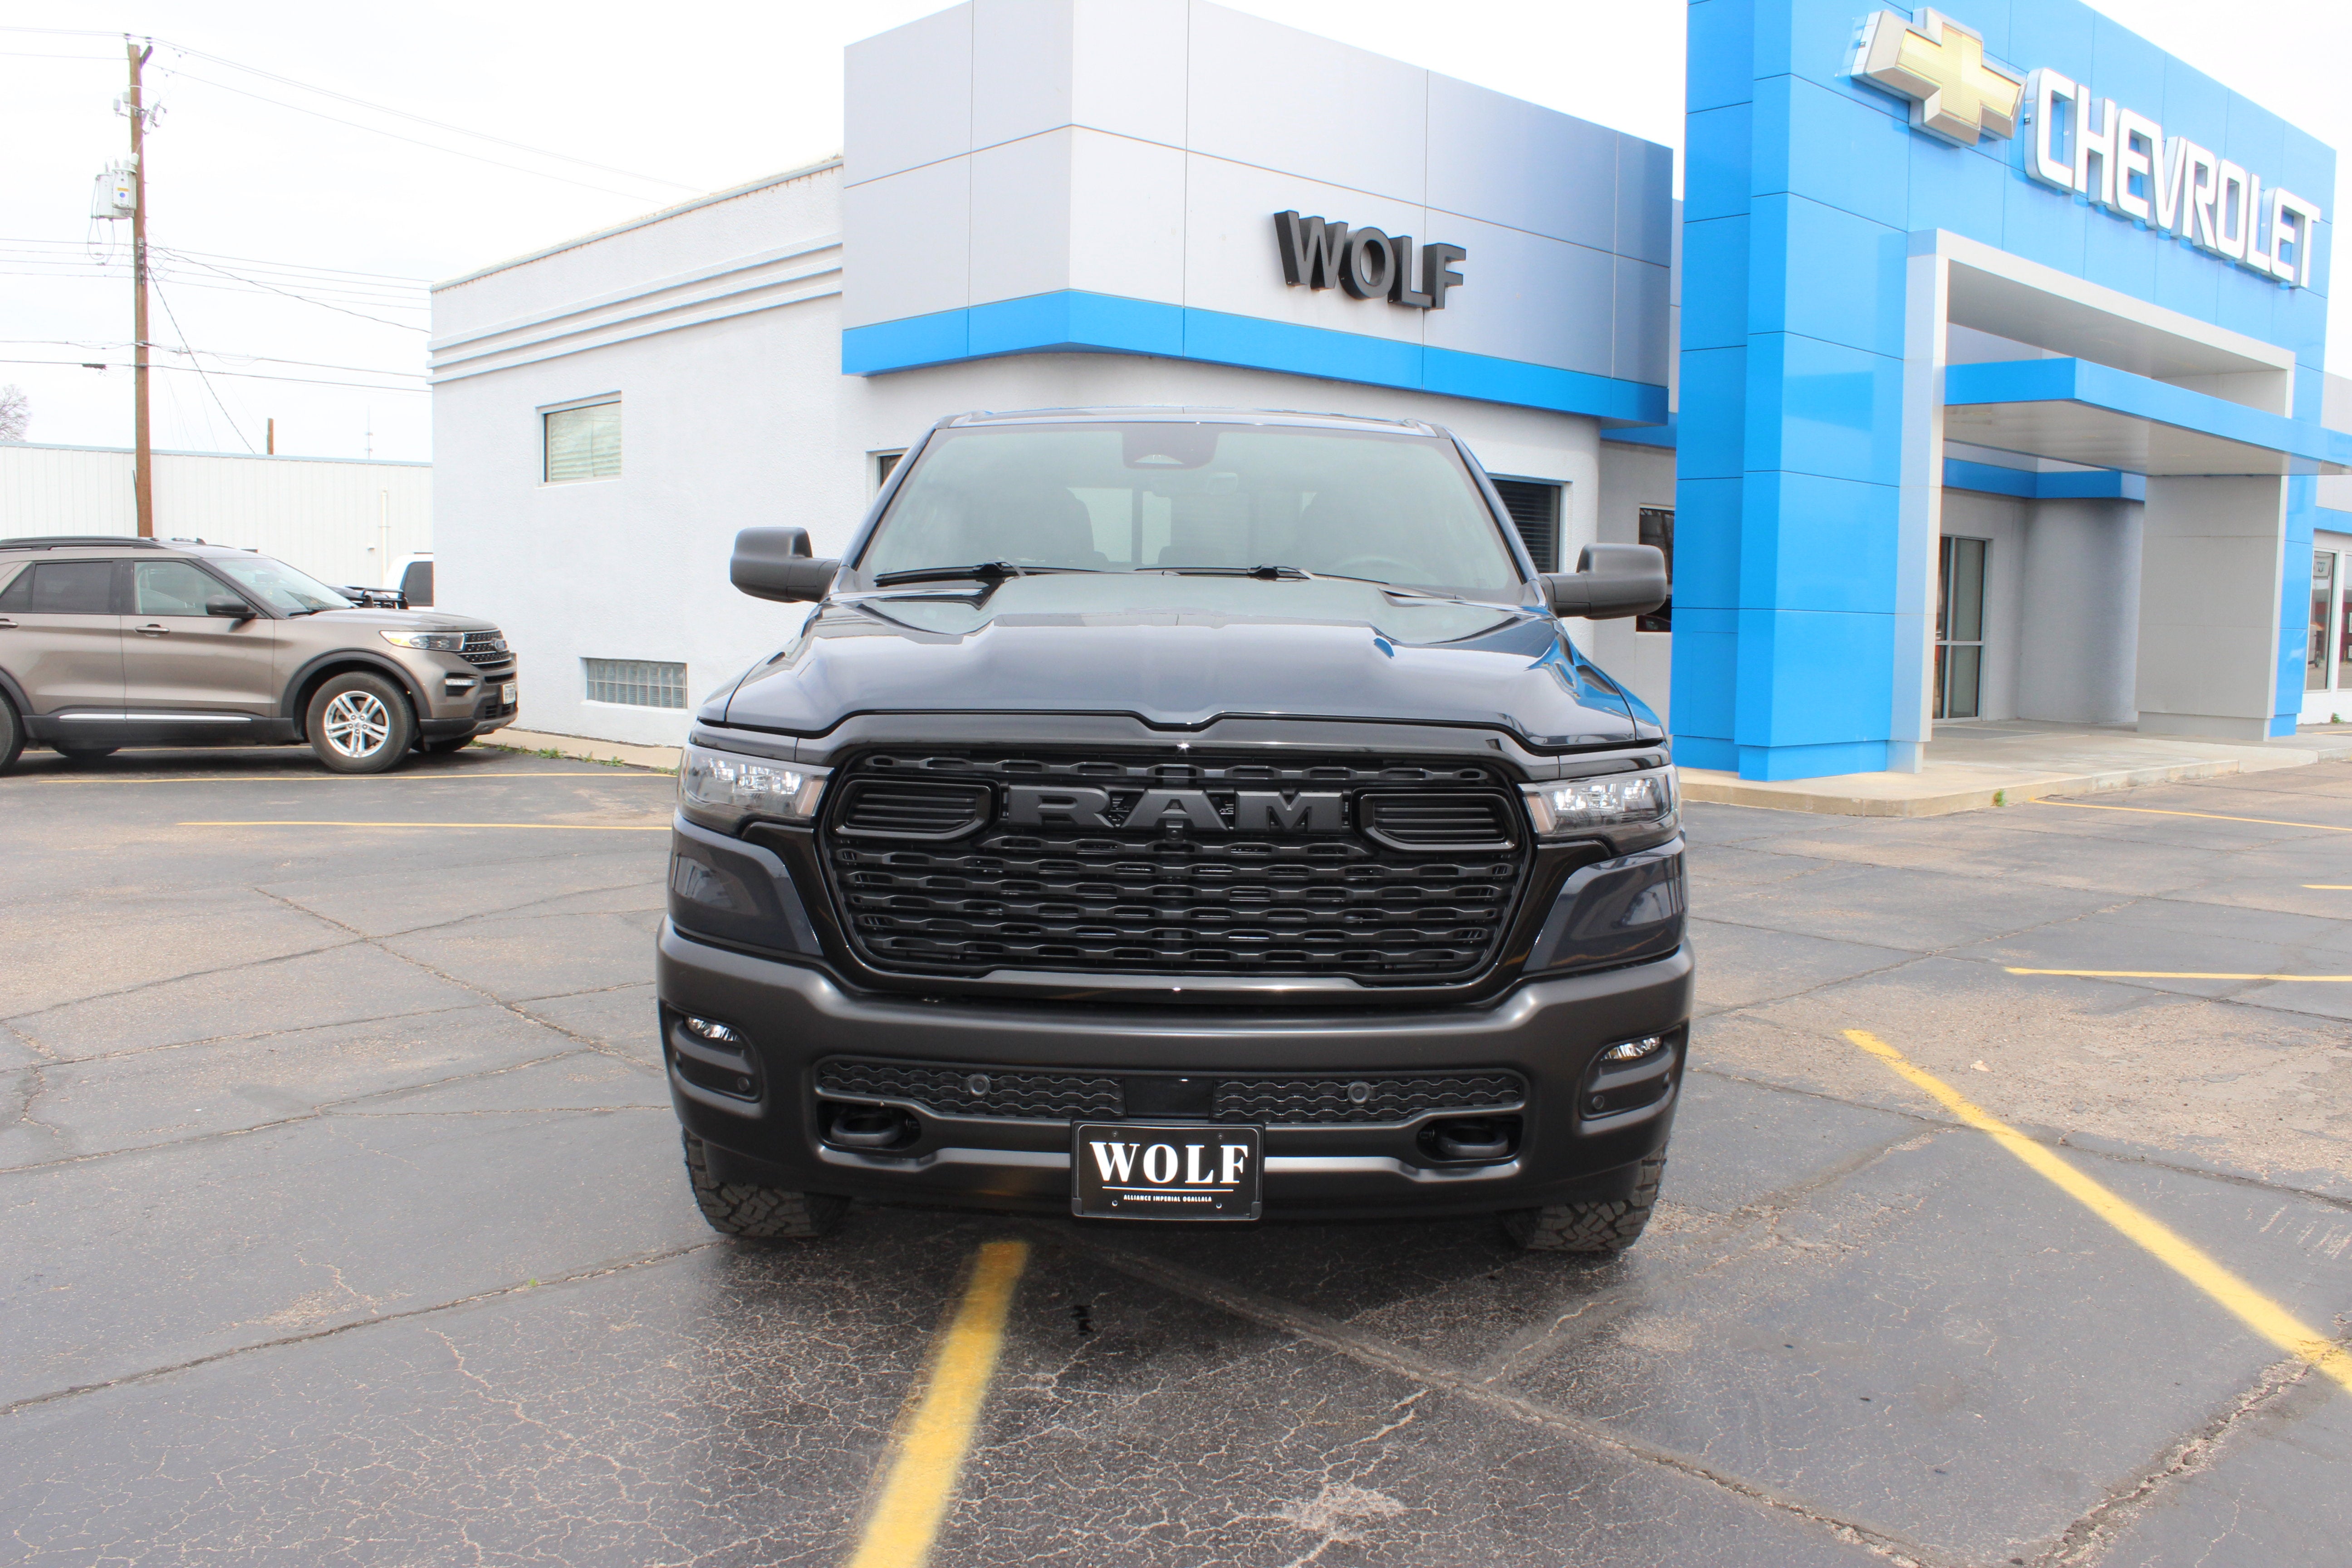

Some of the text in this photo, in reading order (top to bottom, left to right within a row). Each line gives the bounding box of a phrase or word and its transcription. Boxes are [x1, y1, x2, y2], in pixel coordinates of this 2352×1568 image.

[2024, 67, 2321, 289] CHEVROLET
[1274, 210, 1466, 309] WOLF
[1008, 784, 1343, 832] RAM
[1089, 1141, 1249, 1184] WOLF
